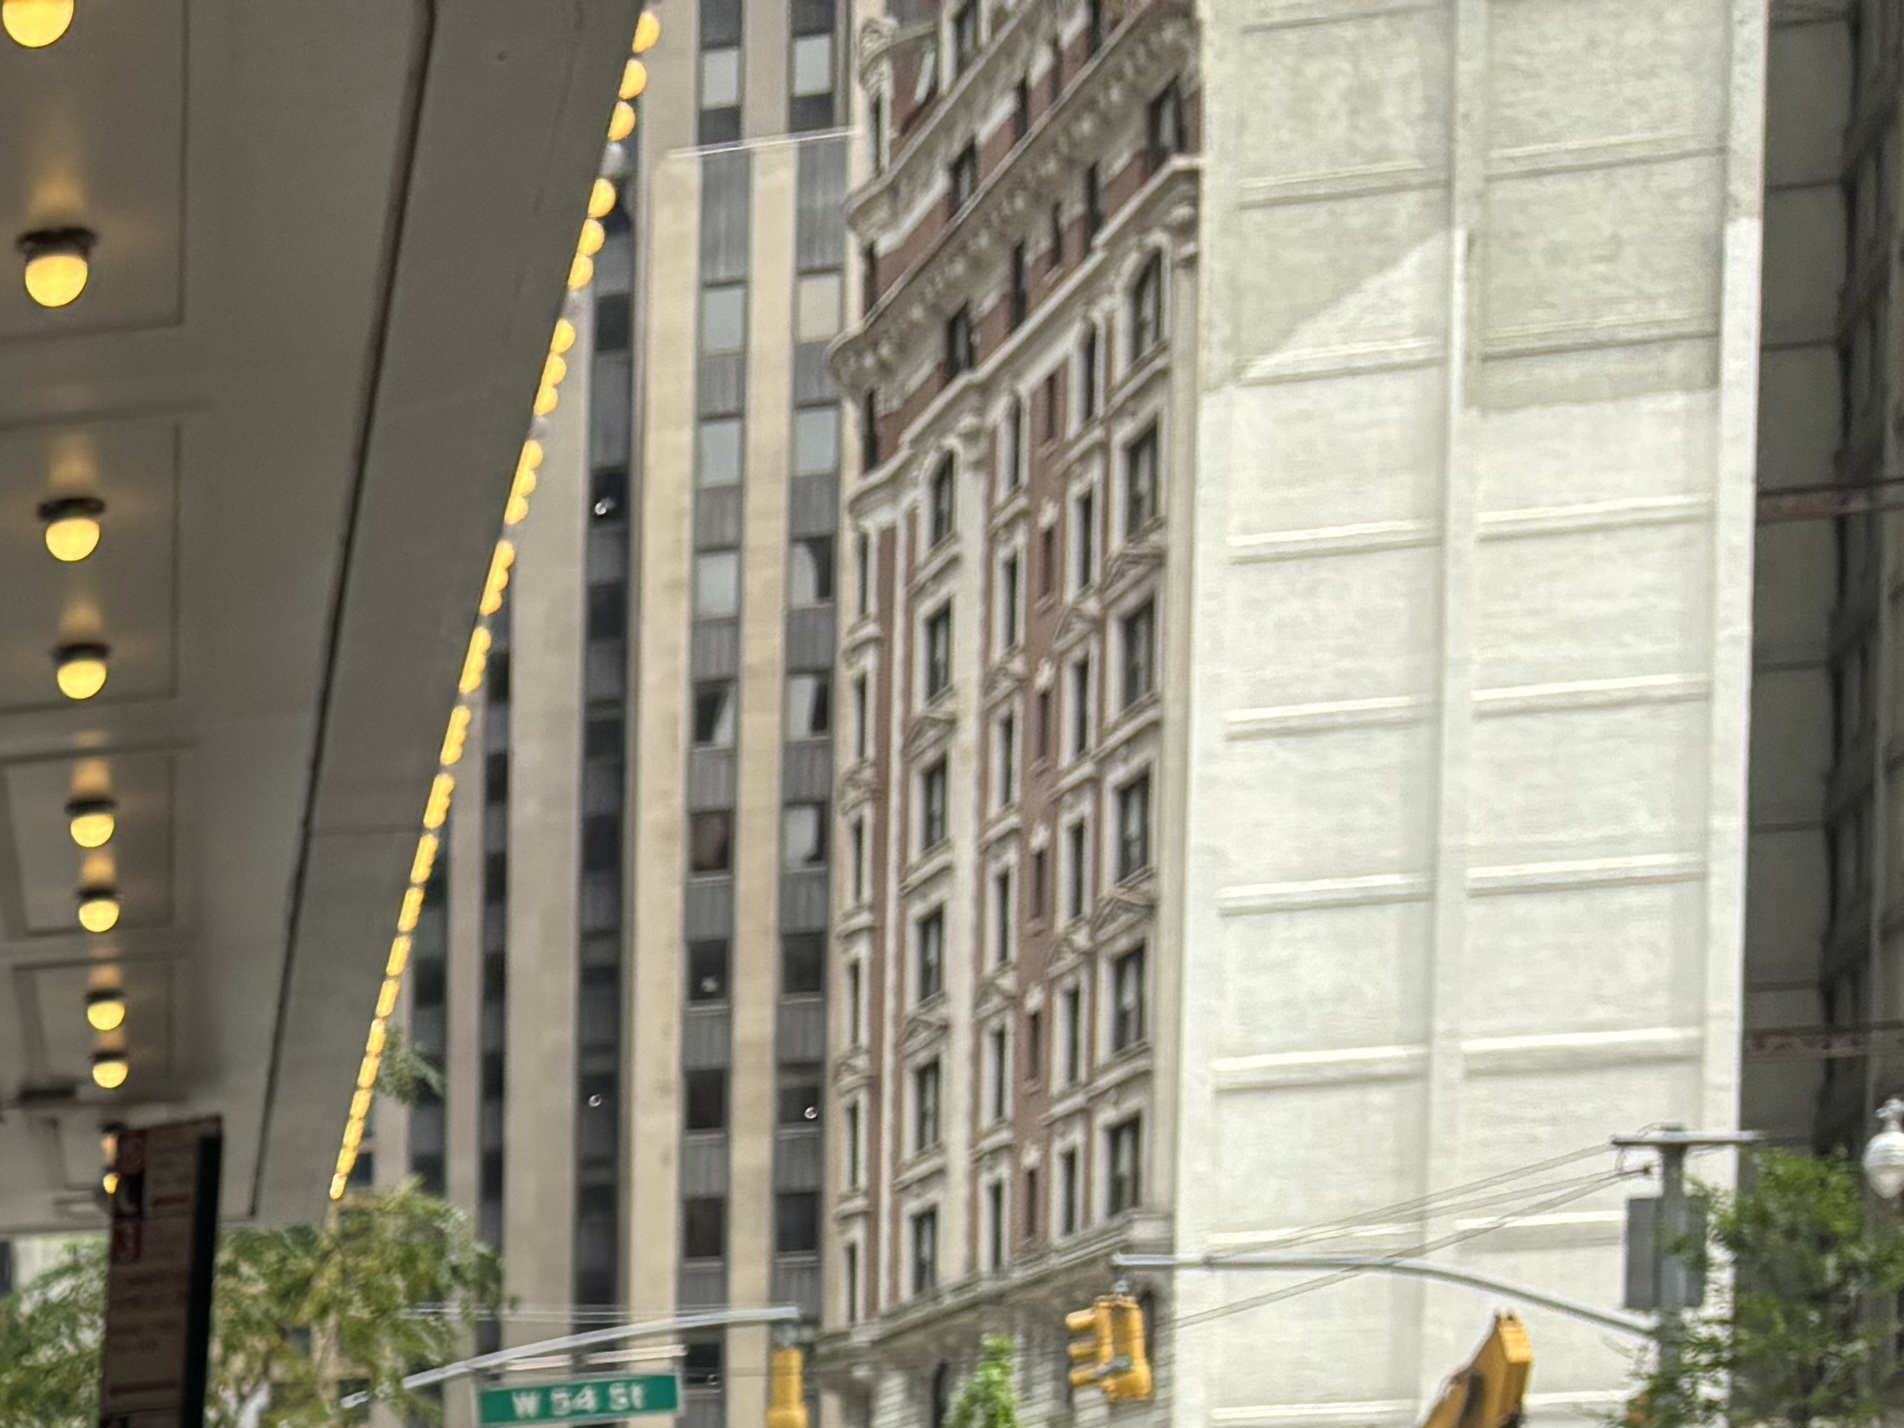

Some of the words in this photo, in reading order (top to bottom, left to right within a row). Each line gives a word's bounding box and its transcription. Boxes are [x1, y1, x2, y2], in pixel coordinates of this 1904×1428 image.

[512, 1390, 540, 1419] W
[551, 1385, 598, 1416] 54
[608, 1382, 645, 1412] St
